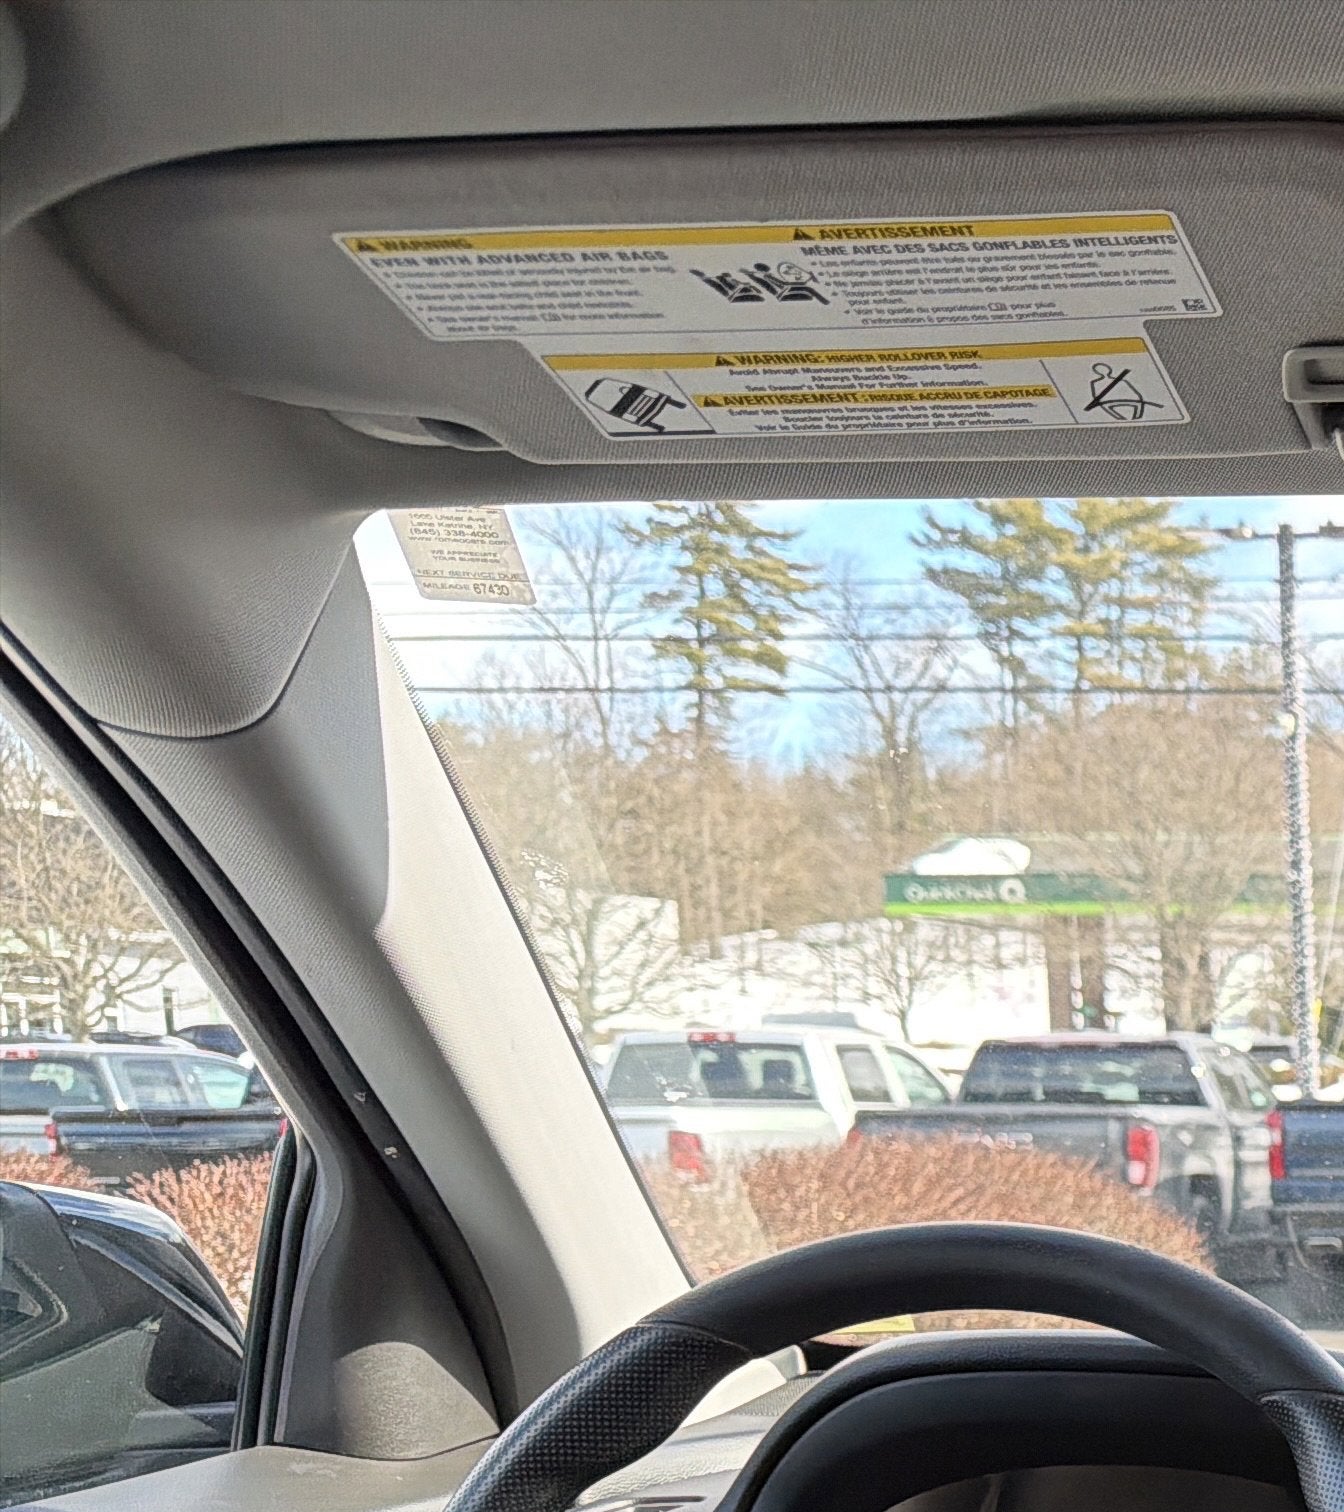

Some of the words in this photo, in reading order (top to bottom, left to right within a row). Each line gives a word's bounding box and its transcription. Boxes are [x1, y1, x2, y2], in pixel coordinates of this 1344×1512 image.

[819, 225, 974, 241] AVERTISSEMENT
[381, 238, 472, 251] WARNING
[853, 244, 893, 254] AVEC
[896, 244, 925, 253] DES
[927, 242, 969, 252] SACS
[973, 239, 1070, 251] GONFLABLES
[1073, 235, 1178, 248] INTELLIGENTS
[370, 257, 419, 266] EVEN
[423, 255, 472, 266] WITH
[477, 252, 575, 264] ADVANCED
[581, 252, 612, 262] AIR
[617, 251, 669, 261] BAGS
[735, 353, 824, 365] WARNING:
[827, 354, 876, 363] HIGHER
[879, 352, 947, 362] ROLLOVER
[951, 350, 981, 360] RISK
[723, 393, 857, 406] AVERTISSEMENT
[869, 393, 917, 401] RISQUE
[919, 392, 963, 401] ACCRU
[965, 391, 982, 399] DE
[983, 388, 1050, 399] CAPOTAGE
